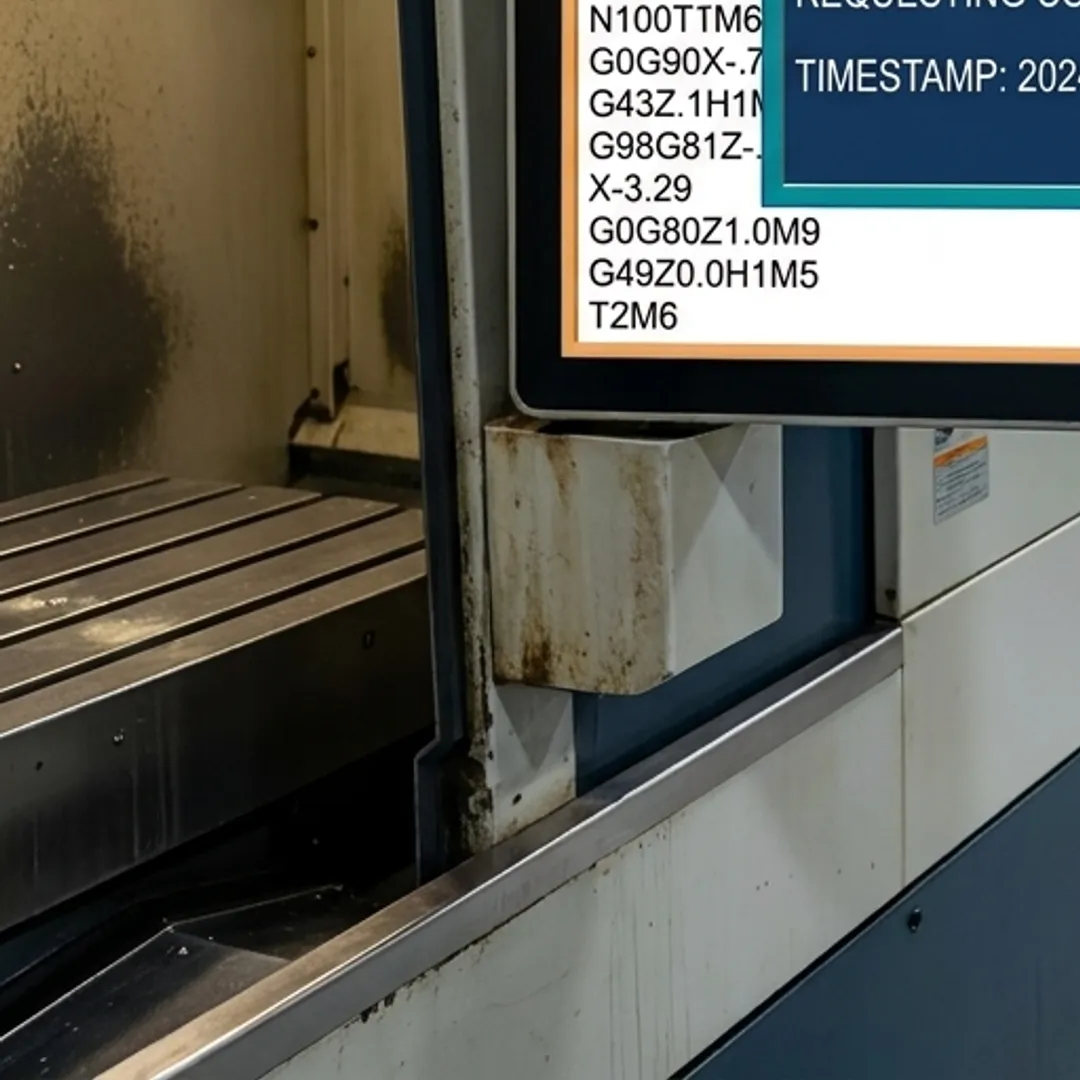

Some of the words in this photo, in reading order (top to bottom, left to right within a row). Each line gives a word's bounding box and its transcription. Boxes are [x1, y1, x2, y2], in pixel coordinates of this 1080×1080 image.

[795, 57, 1007, 94] TIMESTAMP:
[588, 173, 693, 203] X-3.29
[589, 215, 821, 246] G0G80Z1.0M9
[589, 257, 819, 289] G49Z0.0H1M5
[588, 300, 678, 330] T2M6
